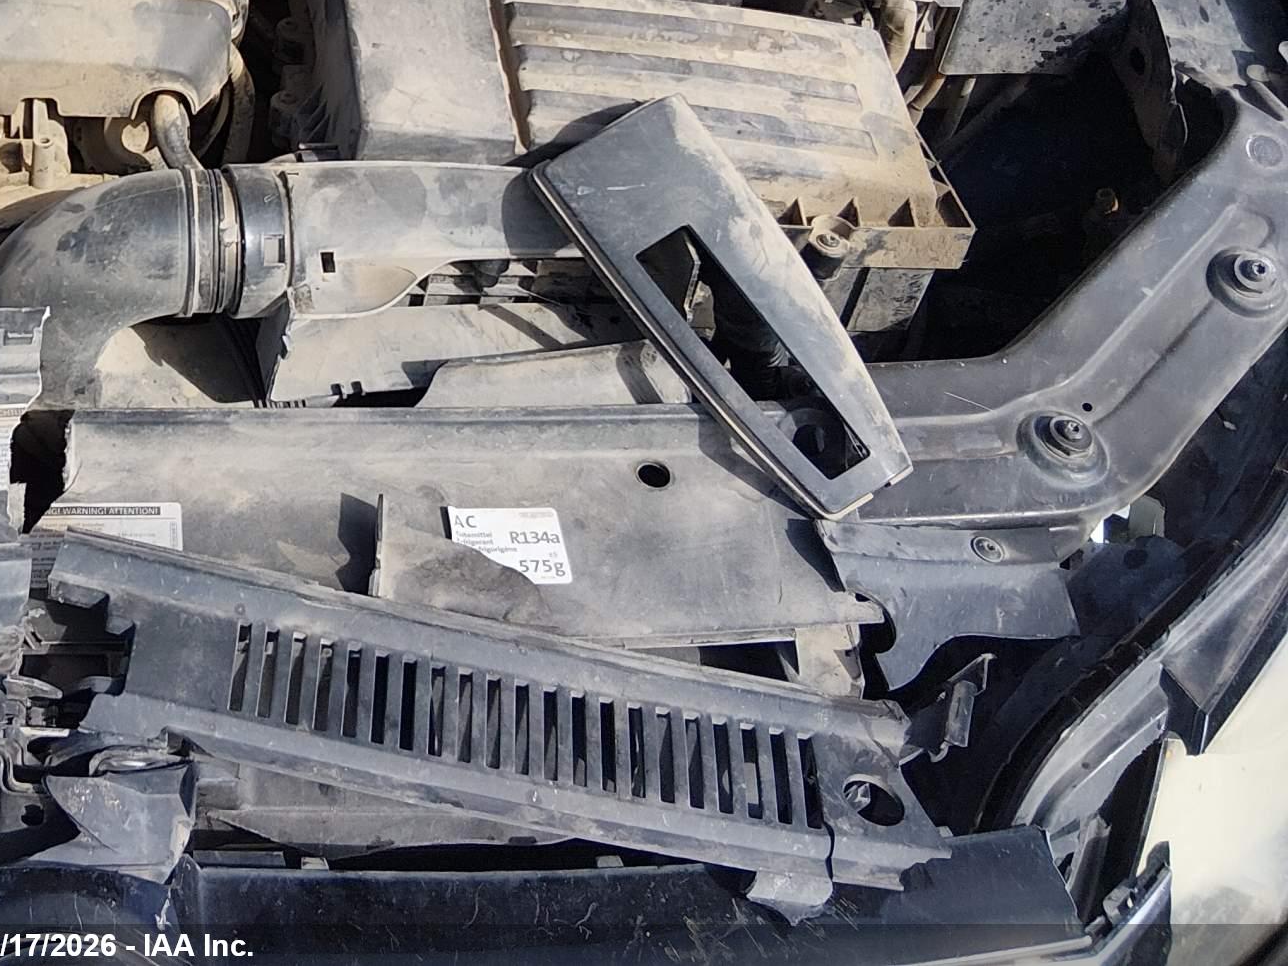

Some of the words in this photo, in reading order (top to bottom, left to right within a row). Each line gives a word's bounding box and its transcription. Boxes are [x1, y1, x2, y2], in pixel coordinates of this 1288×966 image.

[62, 507, 107, 515] WARNING!
[108, 507, 159, 515] ATTENTION!
[509, 531, 560, 544] R134a
[519, 559, 566, 577] 575g
